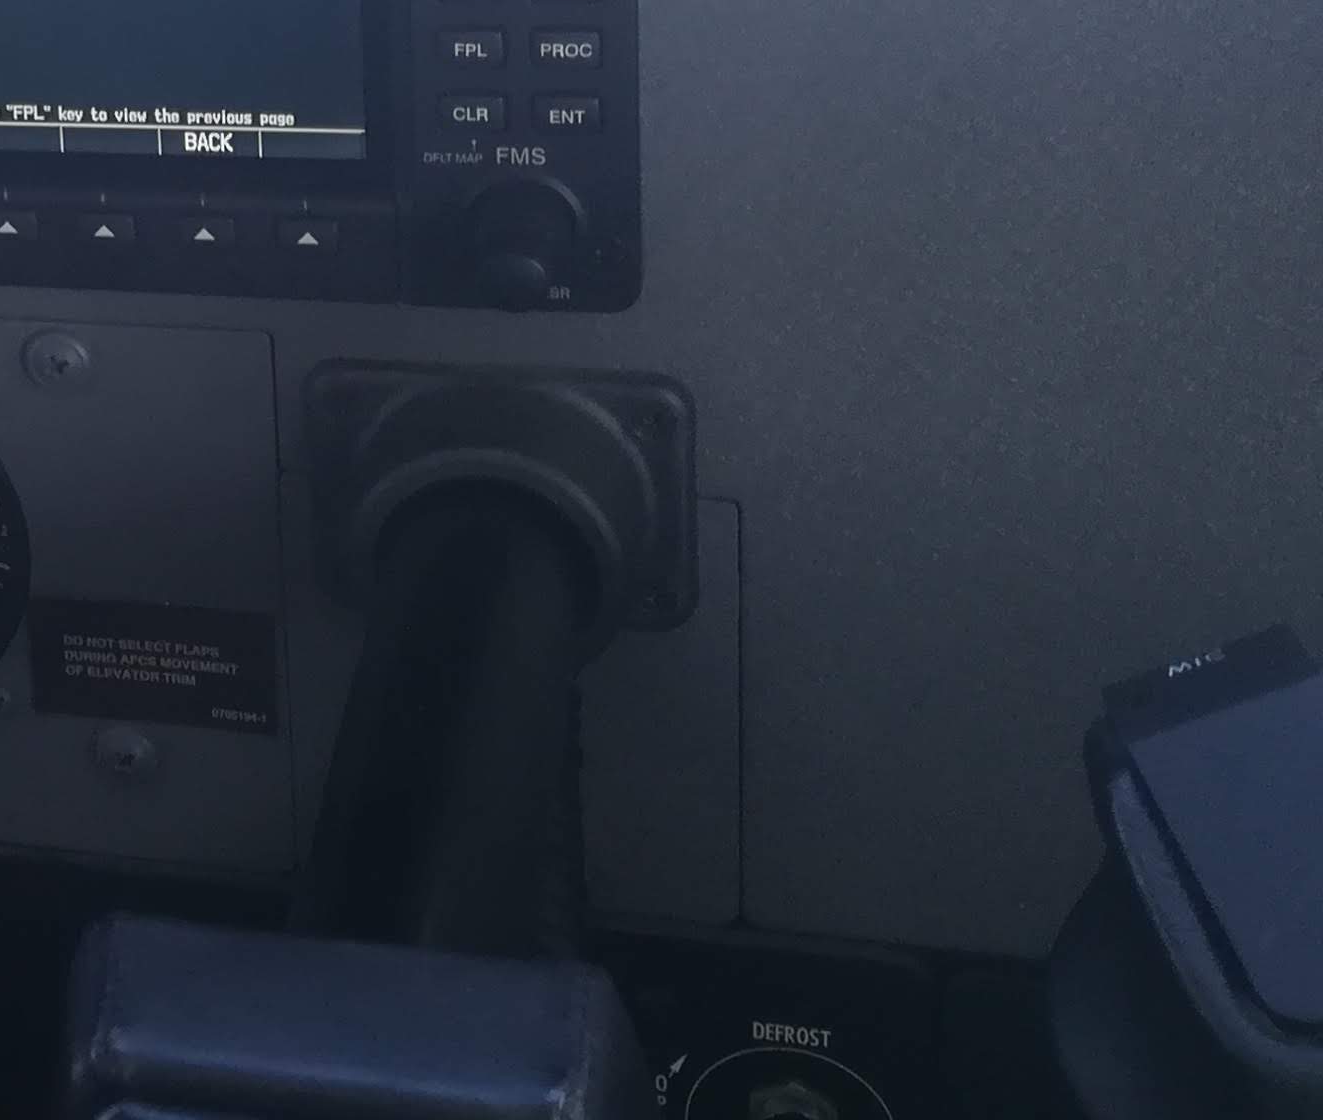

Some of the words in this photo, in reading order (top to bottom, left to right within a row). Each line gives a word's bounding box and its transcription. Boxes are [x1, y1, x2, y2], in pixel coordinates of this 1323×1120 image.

[454, 44, 487, 57] FPL
[540, 44, 592, 58] PROC
[58, 107, 83, 124] key
[90, 107, 107, 122] to
[115, 108, 147, 123] view
[155, 109, 179, 124] the
[187, 109, 252, 127] previous
[259, 111, 294, 128] page
[453, 108, 488, 122] CLR
[549, 110, 585, 124] ENT
[184, 132, 233, 153] BACK
[496, 147, 546, 166] FMS
[752, 1021, 832, 1048] DEFROST
